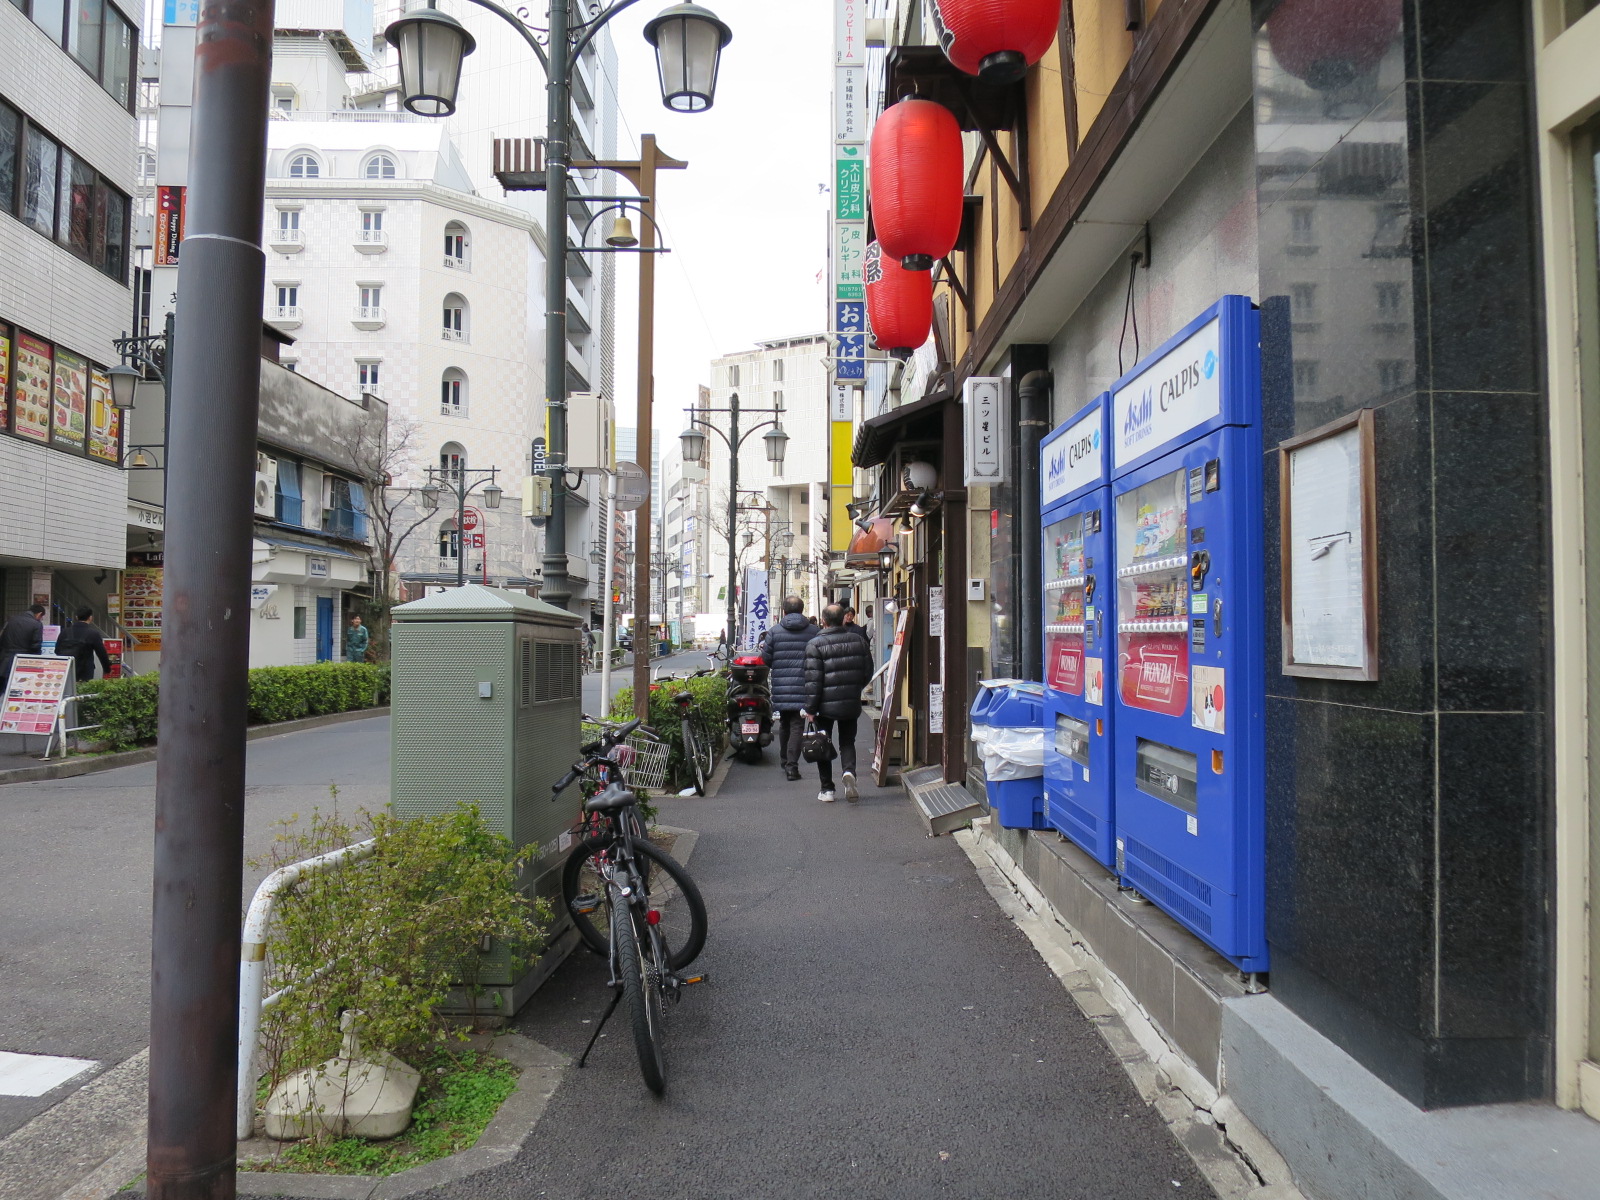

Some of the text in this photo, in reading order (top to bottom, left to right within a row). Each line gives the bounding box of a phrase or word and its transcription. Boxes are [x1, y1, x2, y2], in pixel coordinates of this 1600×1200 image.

[840, 168, 850, 217] クリニック
[850, 162, 860, 213] 大山皮フ科
[841, 226, 850, 281] アレルギー科
[851, 230, 861, 279] 皮フ科
[841, 304, 863, 363] おそば
[1124, 360, 1199, 437] Asahi CALPIS
[982, 397, 990, 455] 三ツ星ビル
[534, 444, 546, 473] HOTEL
[1048, 434, 1091, 481] Asahi CALPIS
[138, 511, 163, 527] 小沼ビル
[1143, 661, 1172, 684] WONDA
